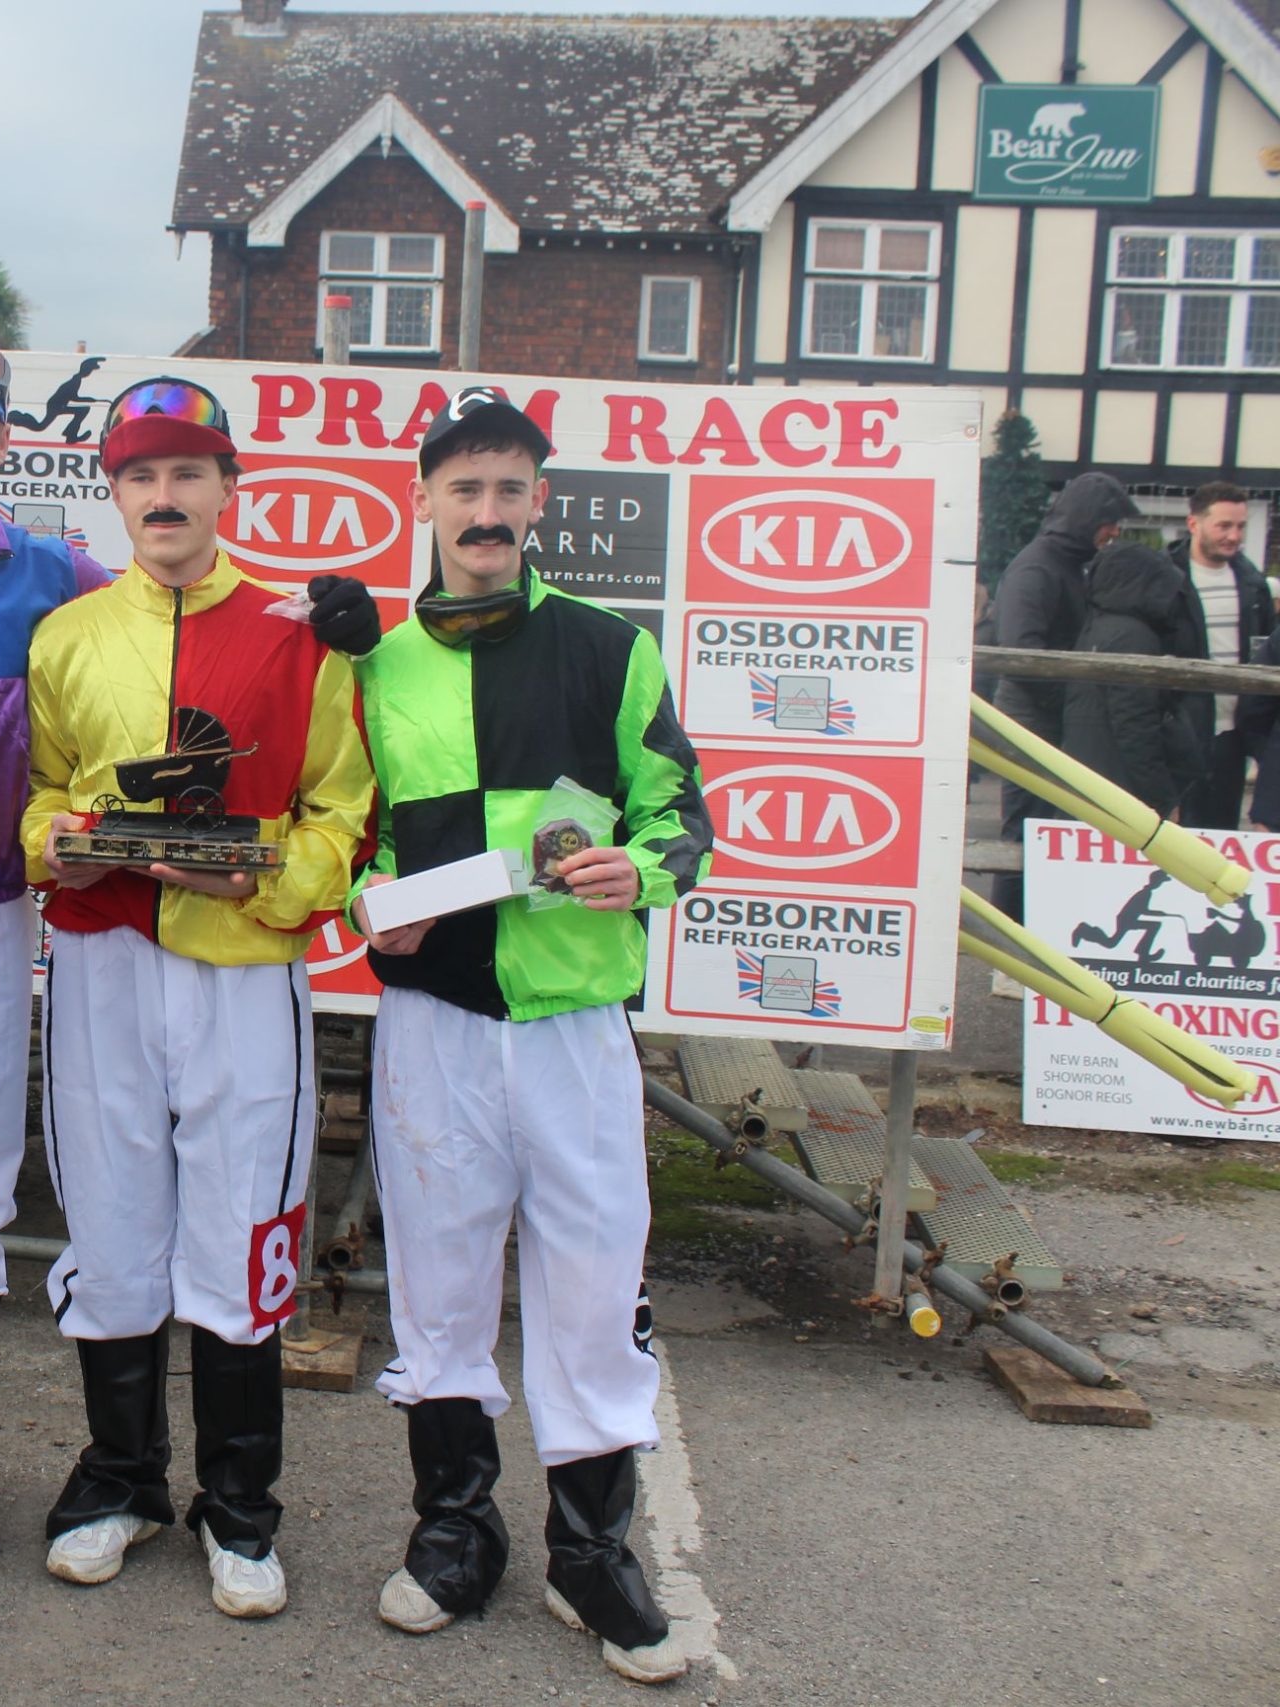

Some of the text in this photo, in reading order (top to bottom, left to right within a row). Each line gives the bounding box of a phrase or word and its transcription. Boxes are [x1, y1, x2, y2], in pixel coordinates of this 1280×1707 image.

[988, 129, 1063, 159] Bear
[601, 394, 902, 469] RACE
[235, 491, 369, 548] KIA
[540, 496, 641, 521] TED
[523, 529, 614, 556] ARN
[739, 515, 876, 568] KIA
[539, 569, 661, 585] arncars.com
[696, 619, 915, 653] OSBORNE
[696, 650, 915, 673] REFRIGERATORS
[726, 788, 865, 847] KIA
[684, 897, 902, 937] OSBORNE
[683, 928, 901, 957] REFRIGERATORS
[1135, 968, 1180, 987] local
[1185, 971, 1266, 992] charities
[1141, 1001, 1279, 1041] OXING
[1050, 1054, 1119, 1069] NEW BARN
[1044, 1070, 1125, 1087] SHOWROOM
[1036, 1087, 1133, 1105] BOGNOR REGIS
[257, 1223, 297, 1313] 8
